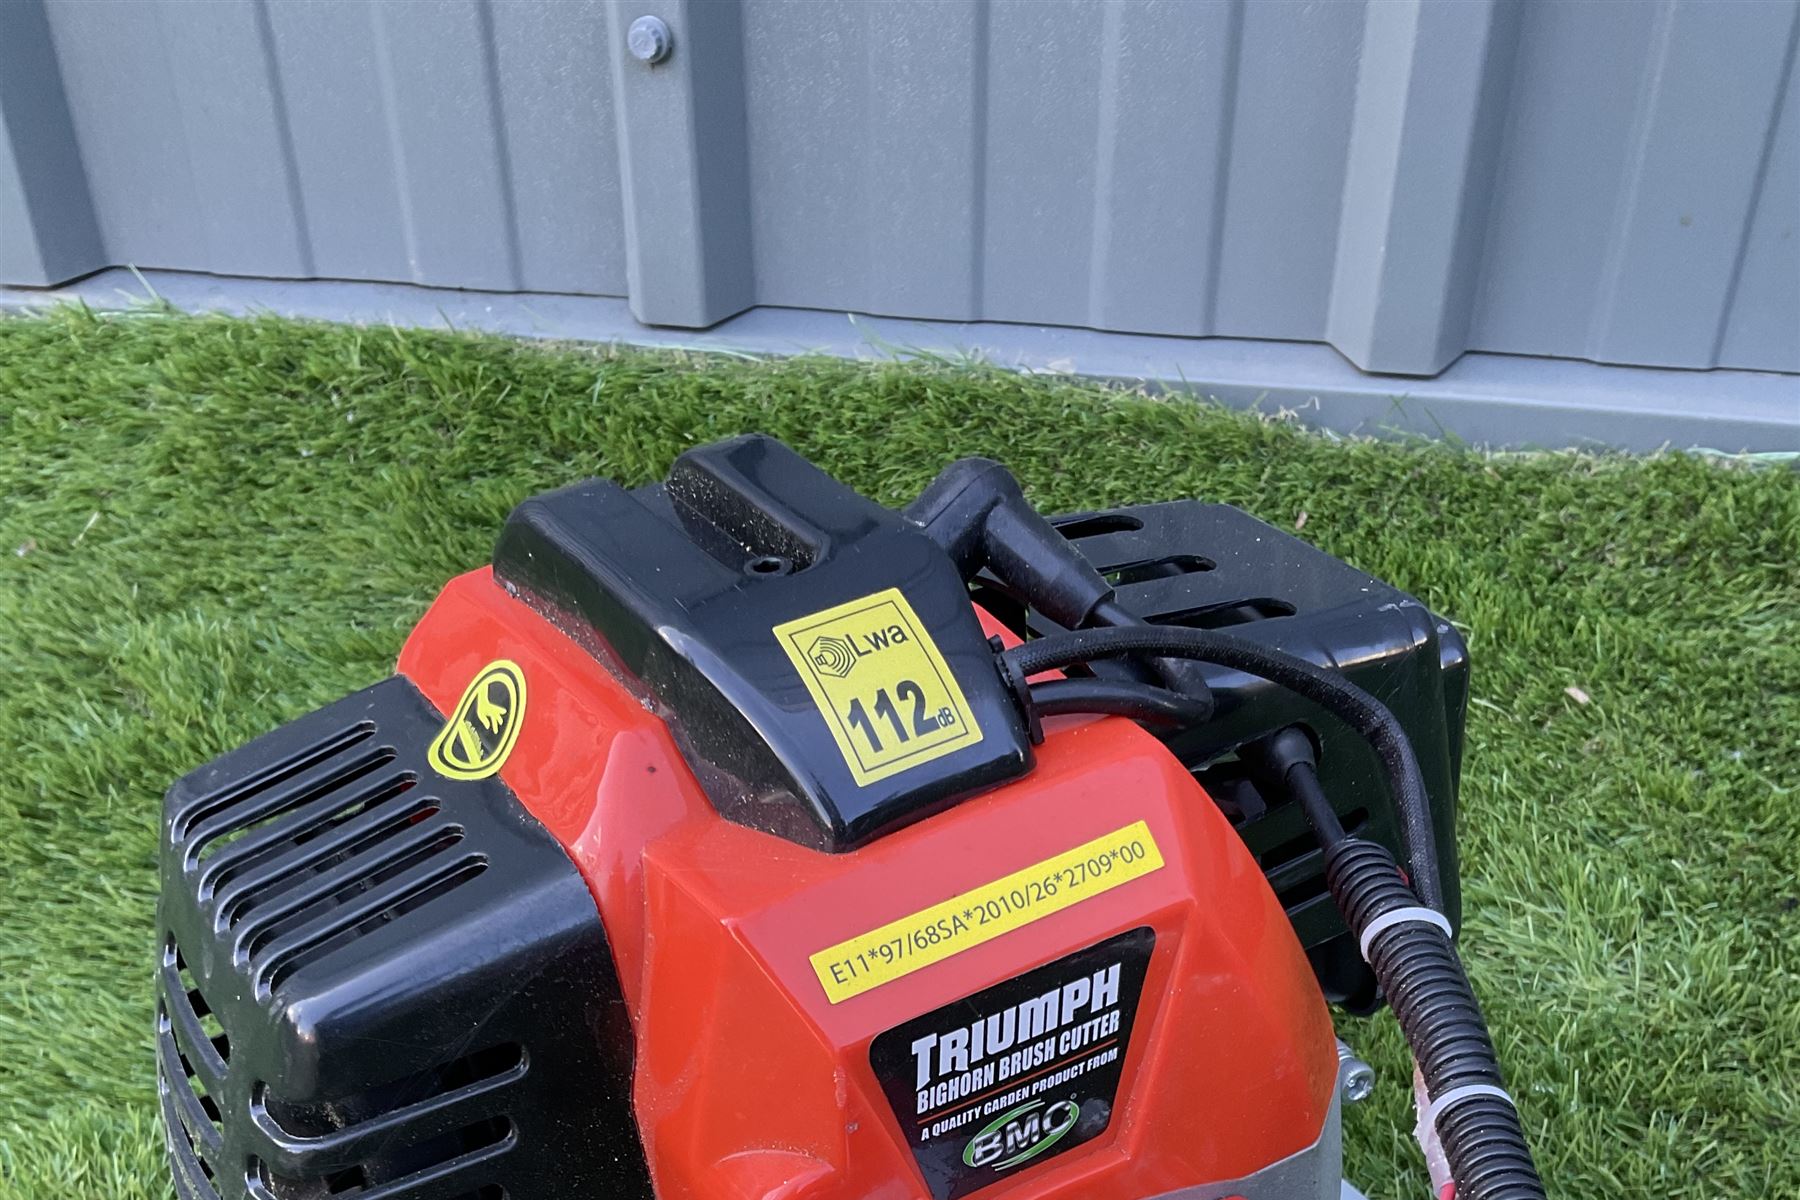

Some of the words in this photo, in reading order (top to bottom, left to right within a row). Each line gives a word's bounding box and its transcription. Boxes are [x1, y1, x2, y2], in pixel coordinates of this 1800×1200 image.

[847, 624, 909, 657] Lwa
[912, 962, 1121, 1091] TRIUMPH
[917, 1062, 995, 1114] BIGHORN
[999, 1036, 1054, 1081] BRUSH
[1059, 1009, 1120, 1055] CUTTER
[921, 1128, 930, 1141] A
[932, 1107, 982, 1137] QUALITY
[984, 1087, 1030, 1116] GARDEN
[1032, 1066, 1085, 1096] PRODUCT
[1087, 1047, 1118, 1073] FROM
[972, 1100, 1074, 1167] BMC
